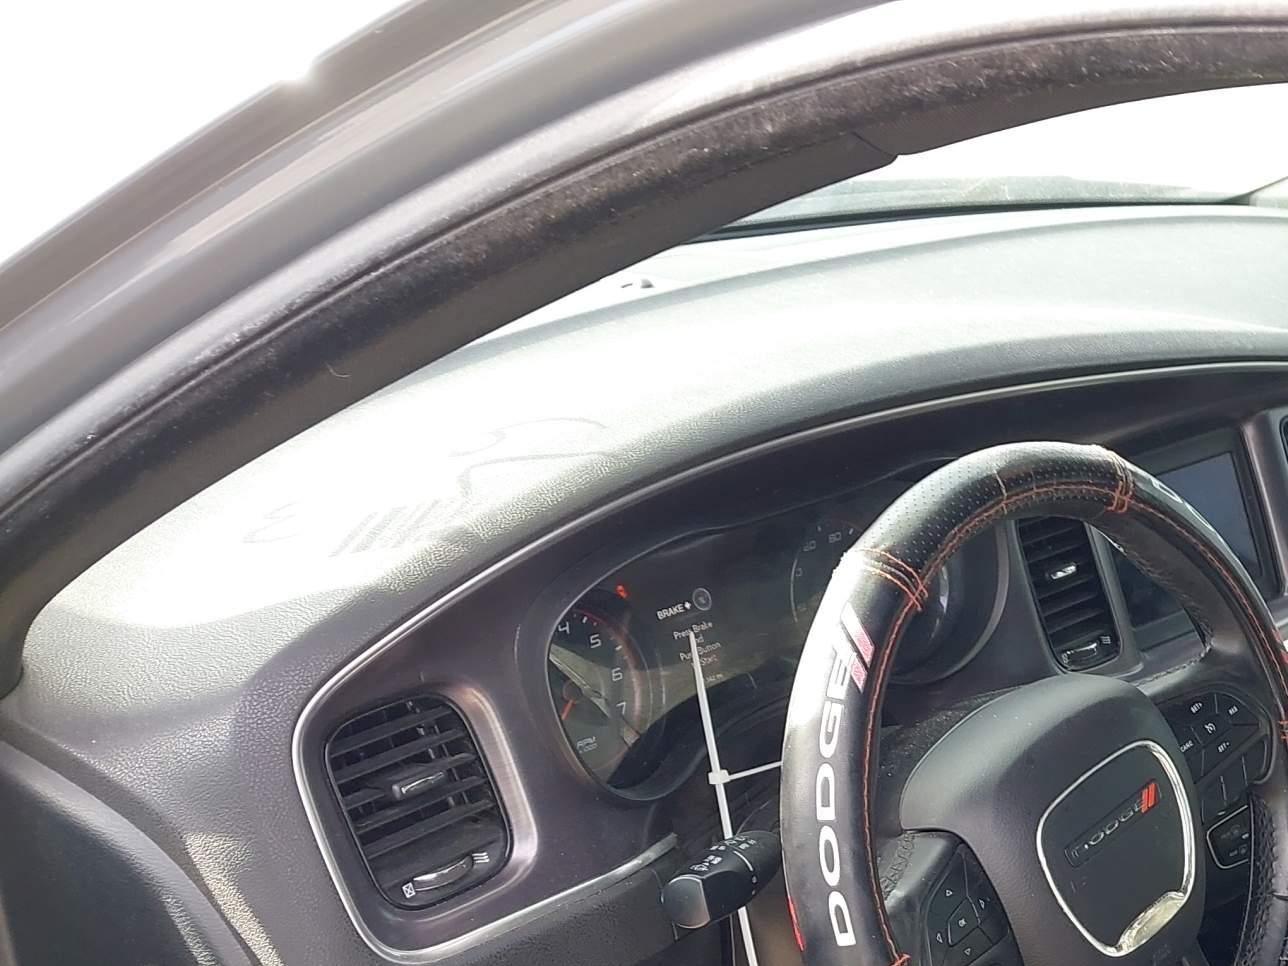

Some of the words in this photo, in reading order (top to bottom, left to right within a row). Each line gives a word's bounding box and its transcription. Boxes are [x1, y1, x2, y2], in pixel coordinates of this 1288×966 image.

[657, 604, 685, 620] BRAKE
[558, 622, 570, 634] 4
[590, 634, 602, 648] 5
[611, 668, 624, 681] 6
[616, 701, 627, 715] 7
[815, 645, 857, 947] DODGE
